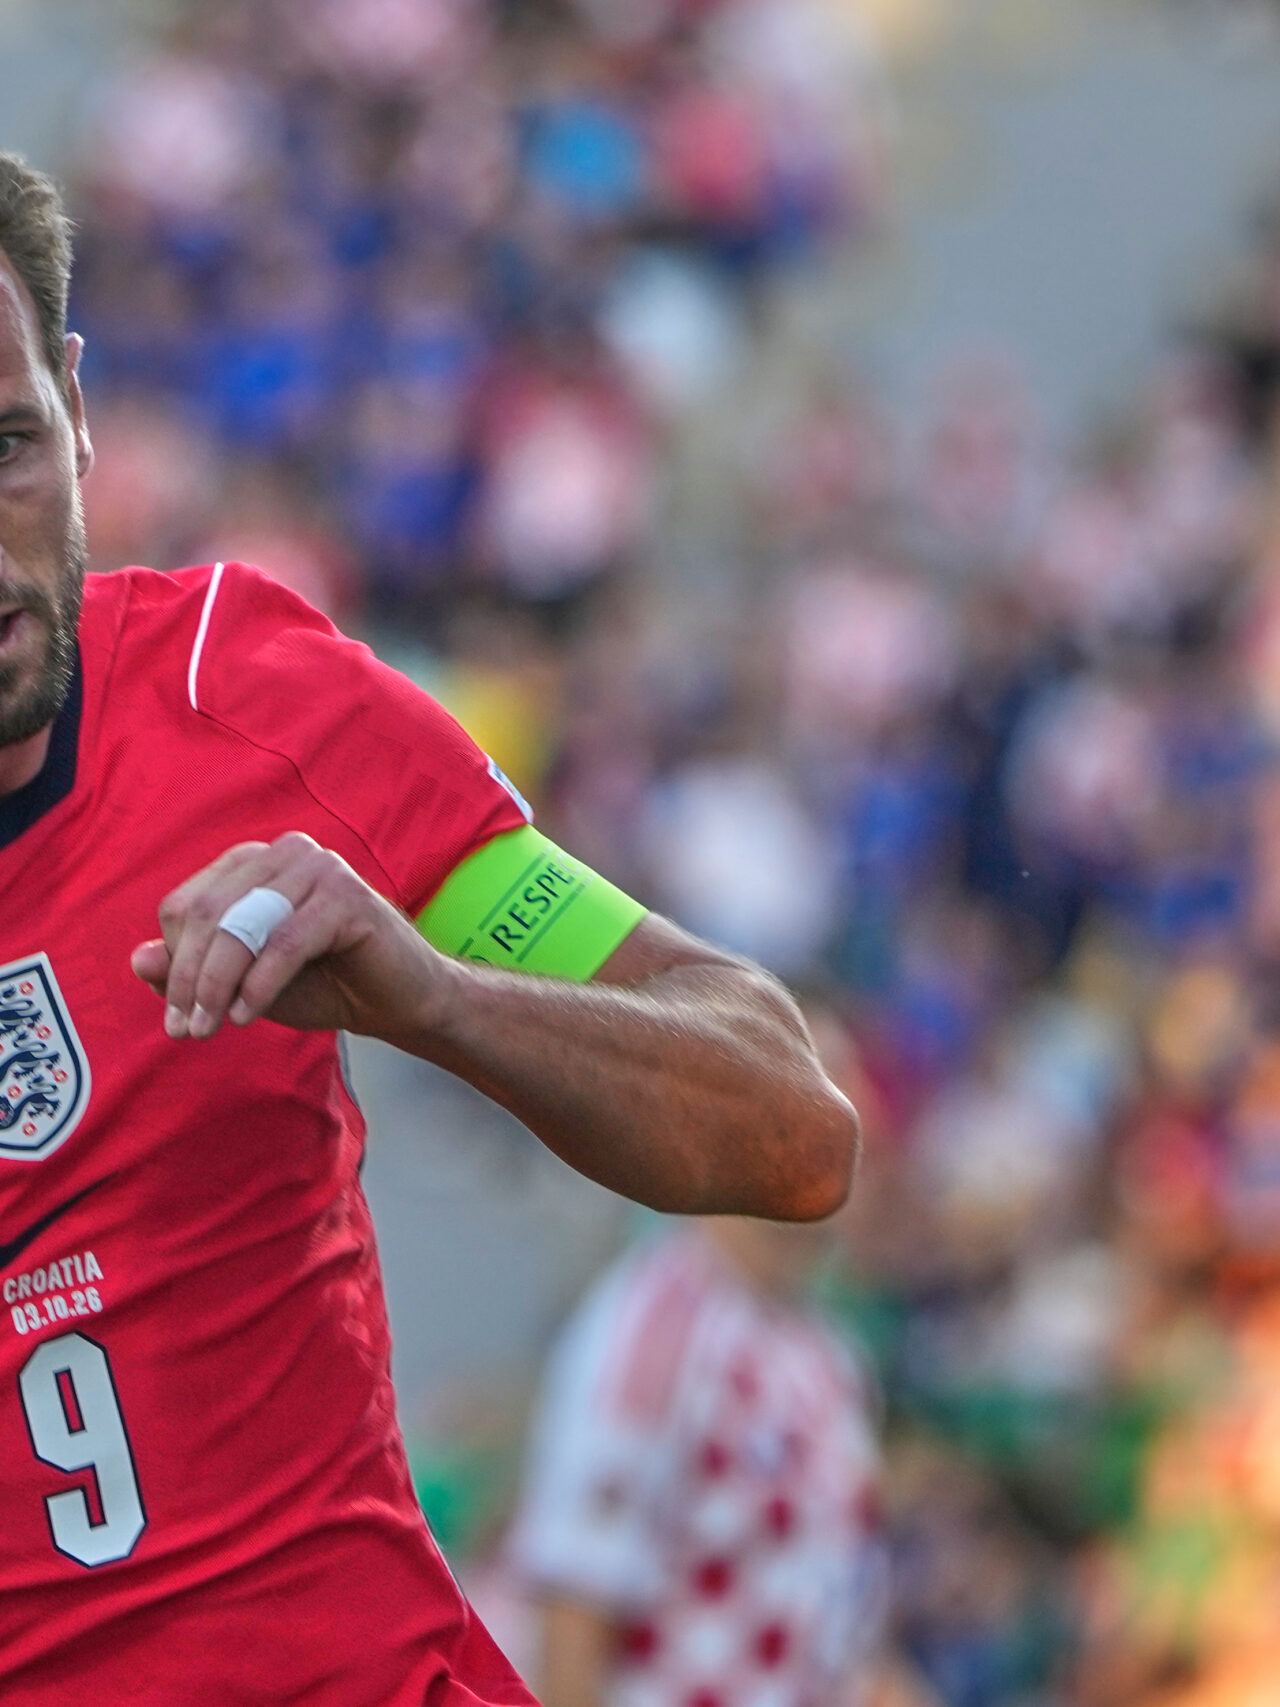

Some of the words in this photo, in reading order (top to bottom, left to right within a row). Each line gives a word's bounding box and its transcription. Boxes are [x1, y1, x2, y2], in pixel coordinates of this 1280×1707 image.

[3, 1251, 104, 1304] CROATIA
[11, 1286, 103, 1335] 03.10.26
[18, 1330, 148, 1570] 9
